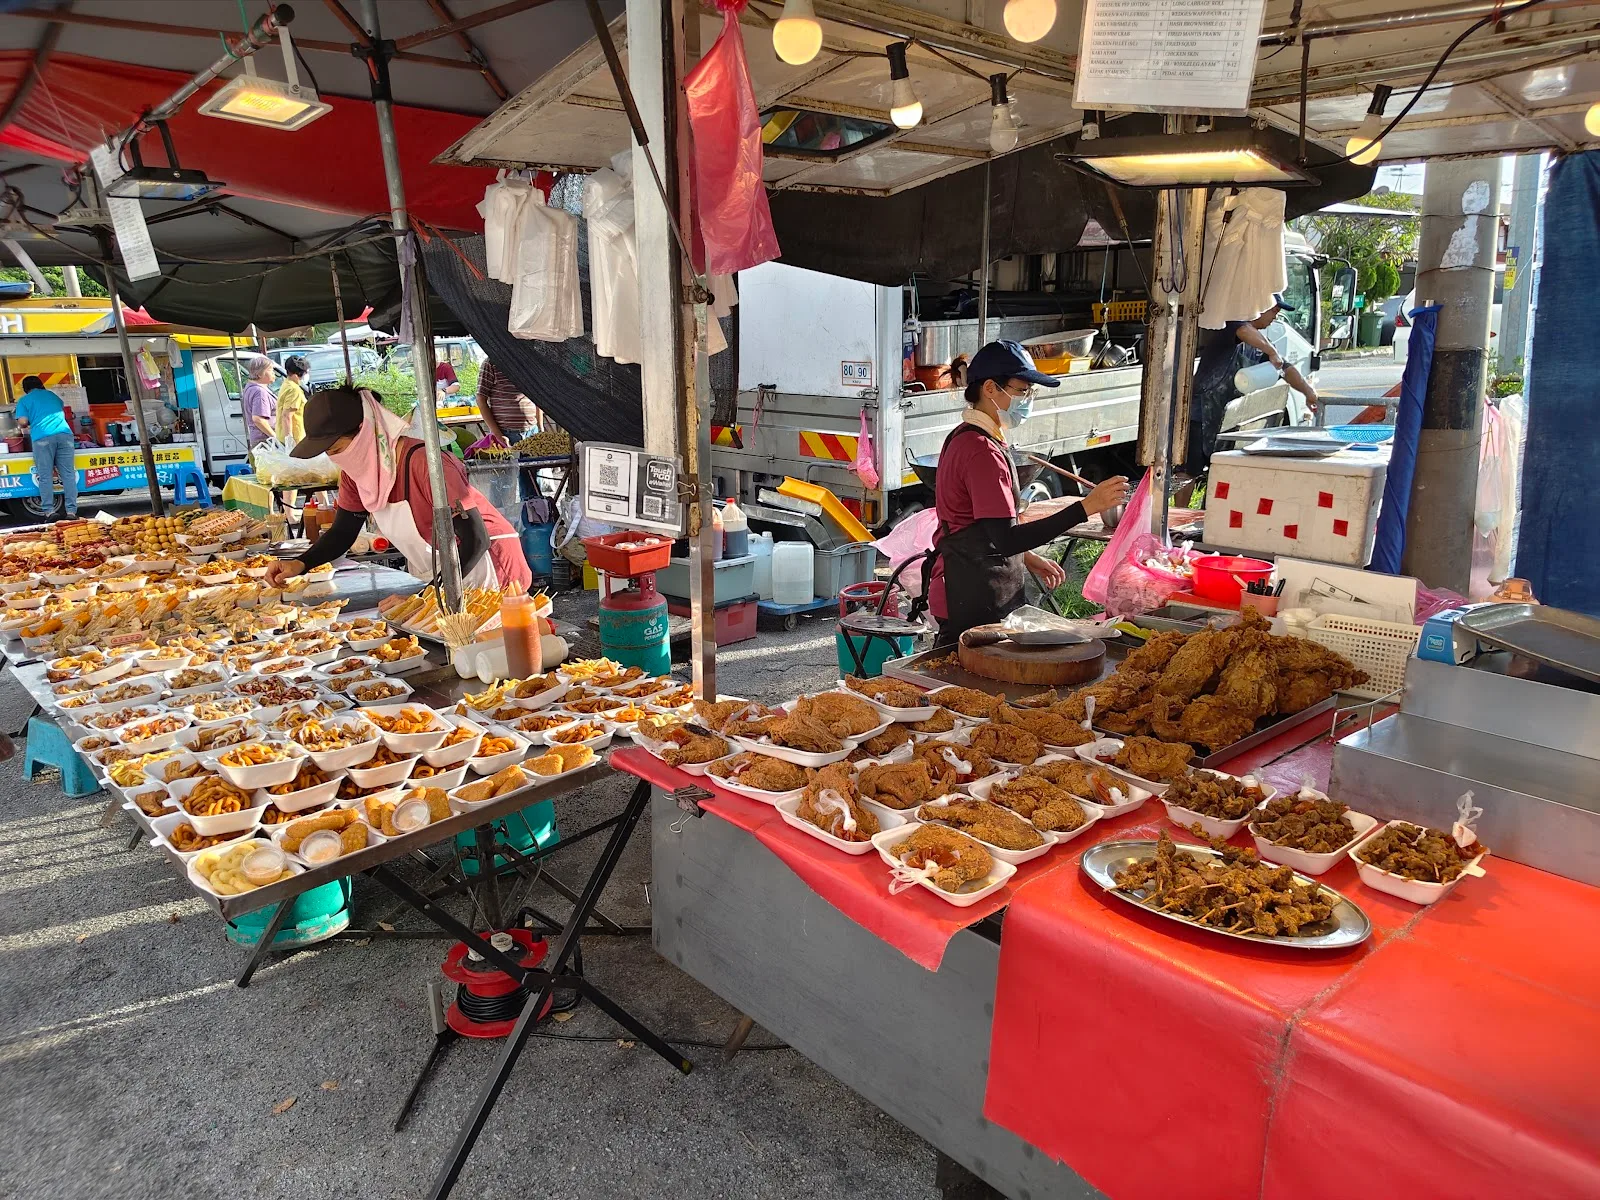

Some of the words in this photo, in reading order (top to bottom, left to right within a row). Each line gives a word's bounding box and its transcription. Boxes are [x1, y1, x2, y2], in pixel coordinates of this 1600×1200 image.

[843, 364, 854, 376] 80
[857, 367, 867, 377] 90
[649, 465, 672, 476] Touch
[0, 476, 23, 488] ILK
[643, 623, 663, 636] GAS
